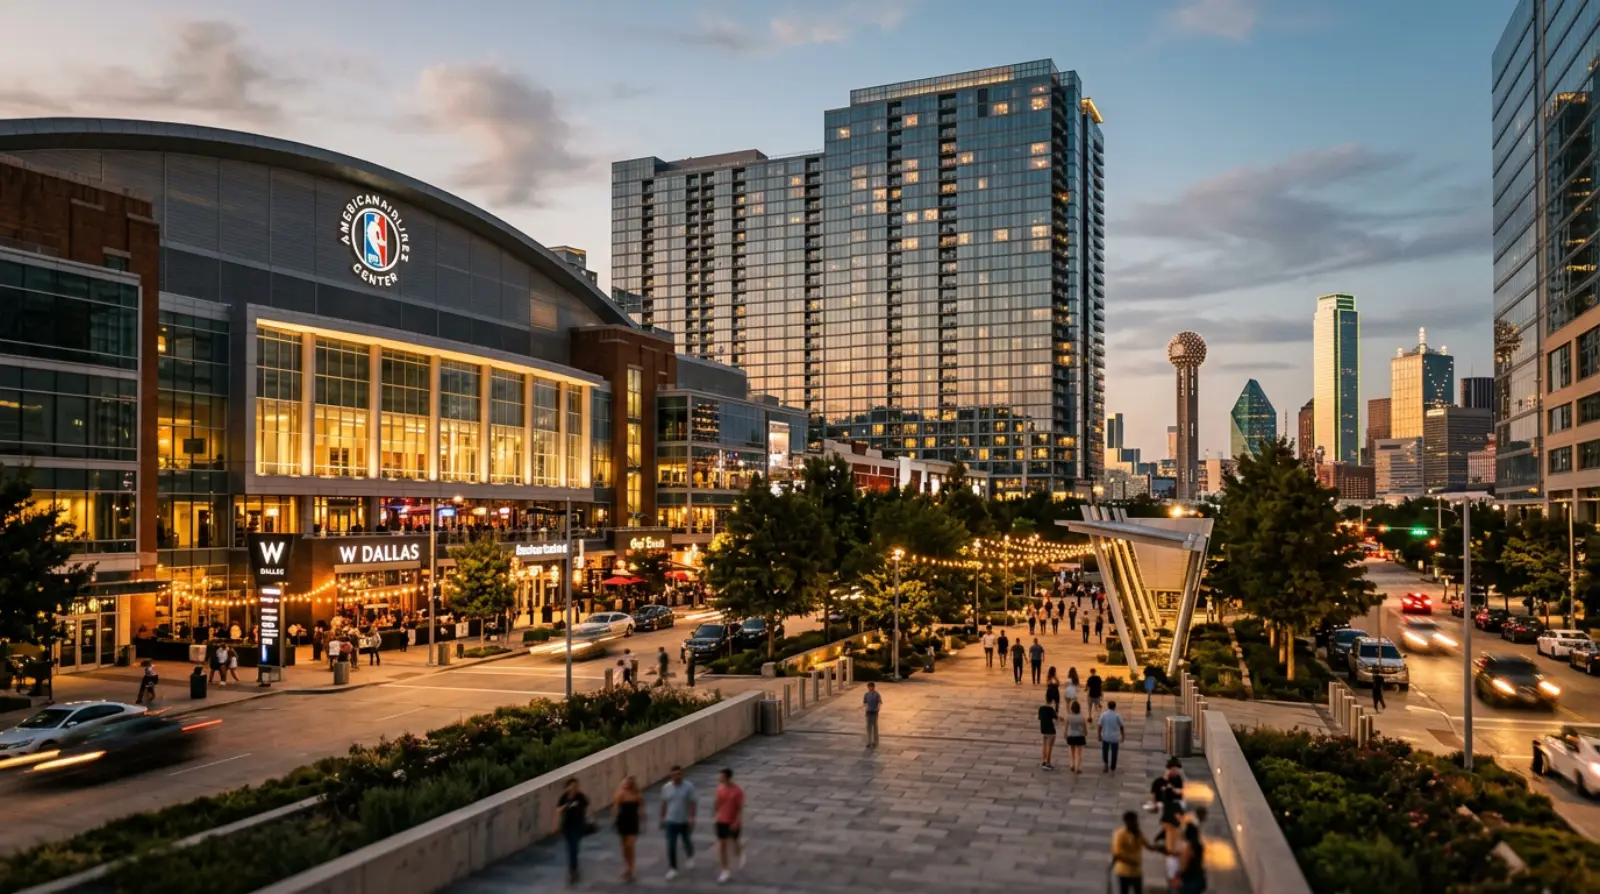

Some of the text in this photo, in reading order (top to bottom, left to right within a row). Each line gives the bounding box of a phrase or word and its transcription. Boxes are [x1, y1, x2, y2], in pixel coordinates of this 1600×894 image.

[353, 263, 398, 287] CENTER
[259, 541, 285, 565] W
[339, 543, 420, 563] W DALLAS
